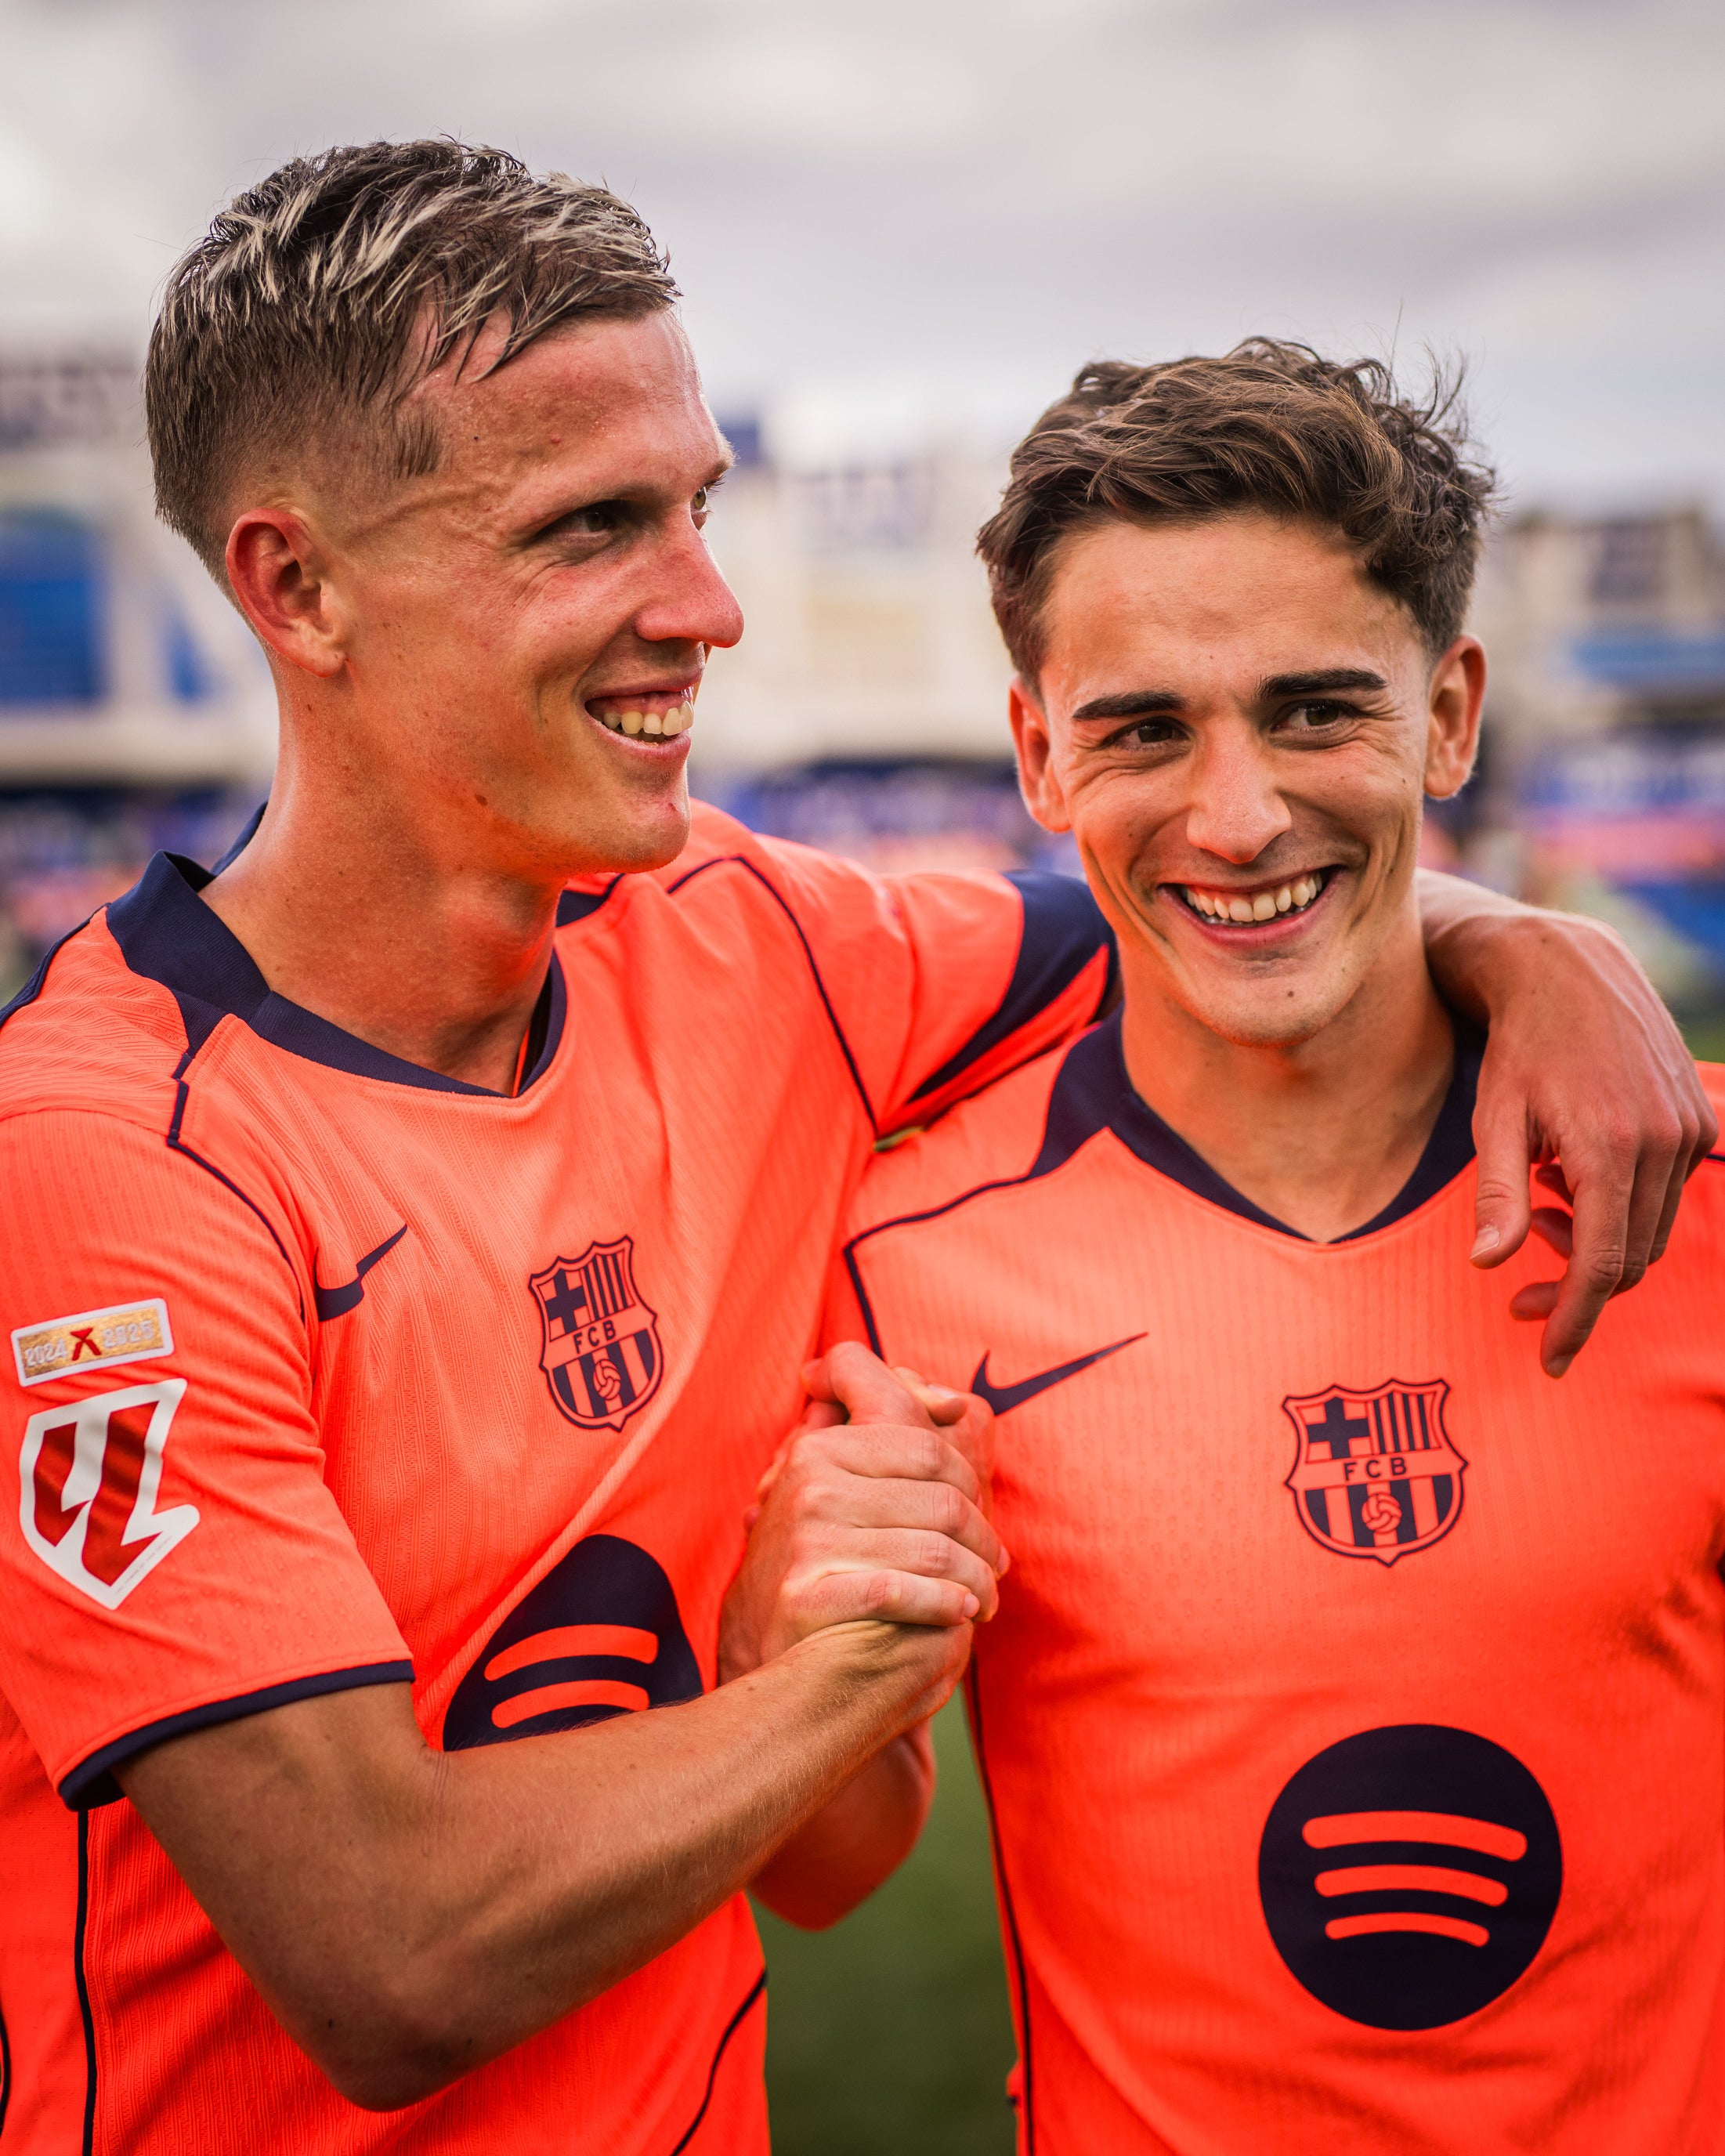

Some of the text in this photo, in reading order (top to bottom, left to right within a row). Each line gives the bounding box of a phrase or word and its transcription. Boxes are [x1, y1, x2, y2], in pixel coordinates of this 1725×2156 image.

[24, 1338, 68, 1367] 2024
[102, 1319, 154, 1348] 2025
[573, 1320, 616, 1354] FCB
[1343, 1456, 1407, 1481] FCB
